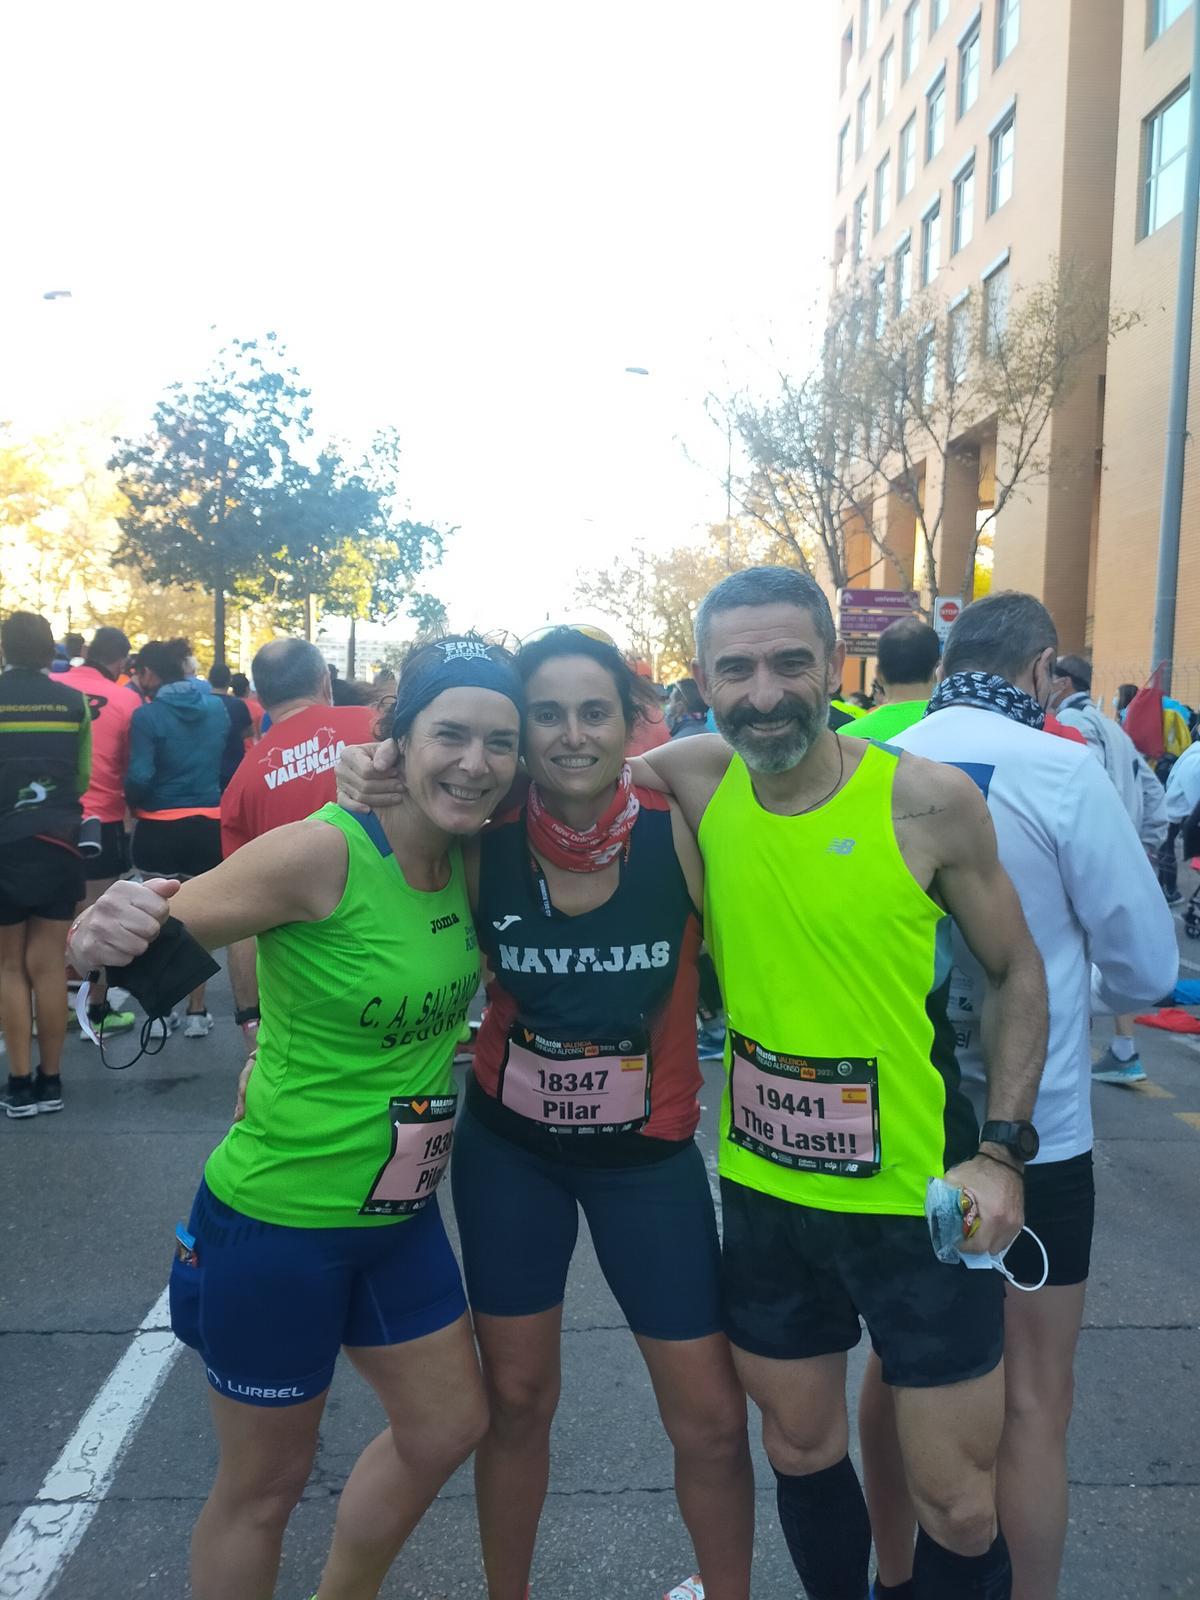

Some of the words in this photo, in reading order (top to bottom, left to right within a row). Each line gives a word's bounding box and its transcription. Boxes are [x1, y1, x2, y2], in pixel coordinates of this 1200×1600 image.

[264, 740, 346, 790] VALENCIA
[281, 736, 319, 766] RUN
[499, 940, 670, 974] NAVAJAS
[360, 996, 382, 1028] C.
[777, 1056, 808, 1067] VALENCIA
[537, 1068, 609, 1092] 18347
[543, 1101, 600, 1120] Pilar
[756, 1084, 825, 1119] 19441
[741, 1105, 774, 1141] The
[781, 1124, 856, 1154] Last!!
[227, 1380, 304, 1398] LURBEL
